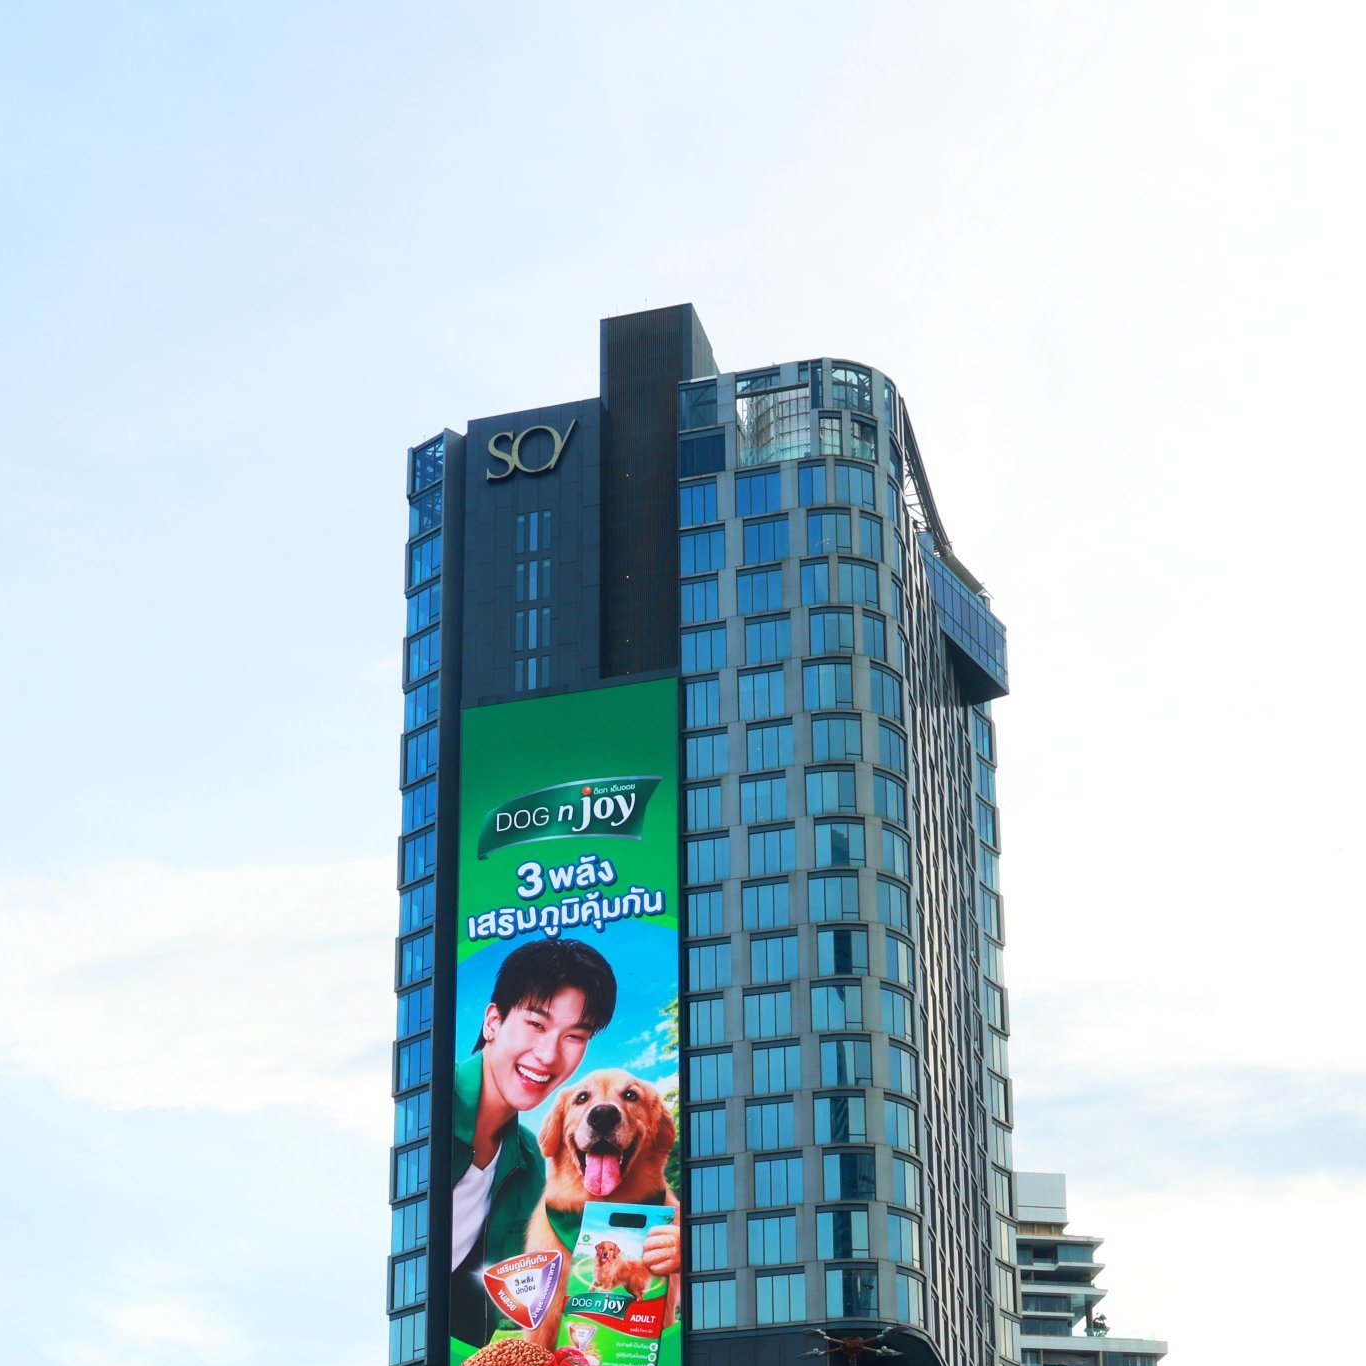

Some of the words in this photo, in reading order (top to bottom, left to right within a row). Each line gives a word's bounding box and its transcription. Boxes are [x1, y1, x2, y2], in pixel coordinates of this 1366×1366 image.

[496, 806, 550, 832] DOG
[557, 804, 574, 822] n
[571, 787, 636, 832] joy
[516, 861, 544, 898] 3
[548, 855, 615, 890] พลัง
[468, 886, 663, 938] เสริมภูมิคุ้มกัน
[571, 1298, 593, 1307] DOG
[600, 1296, 625, 1313] joy
[629, 1314, 656, 1323] ADULT
